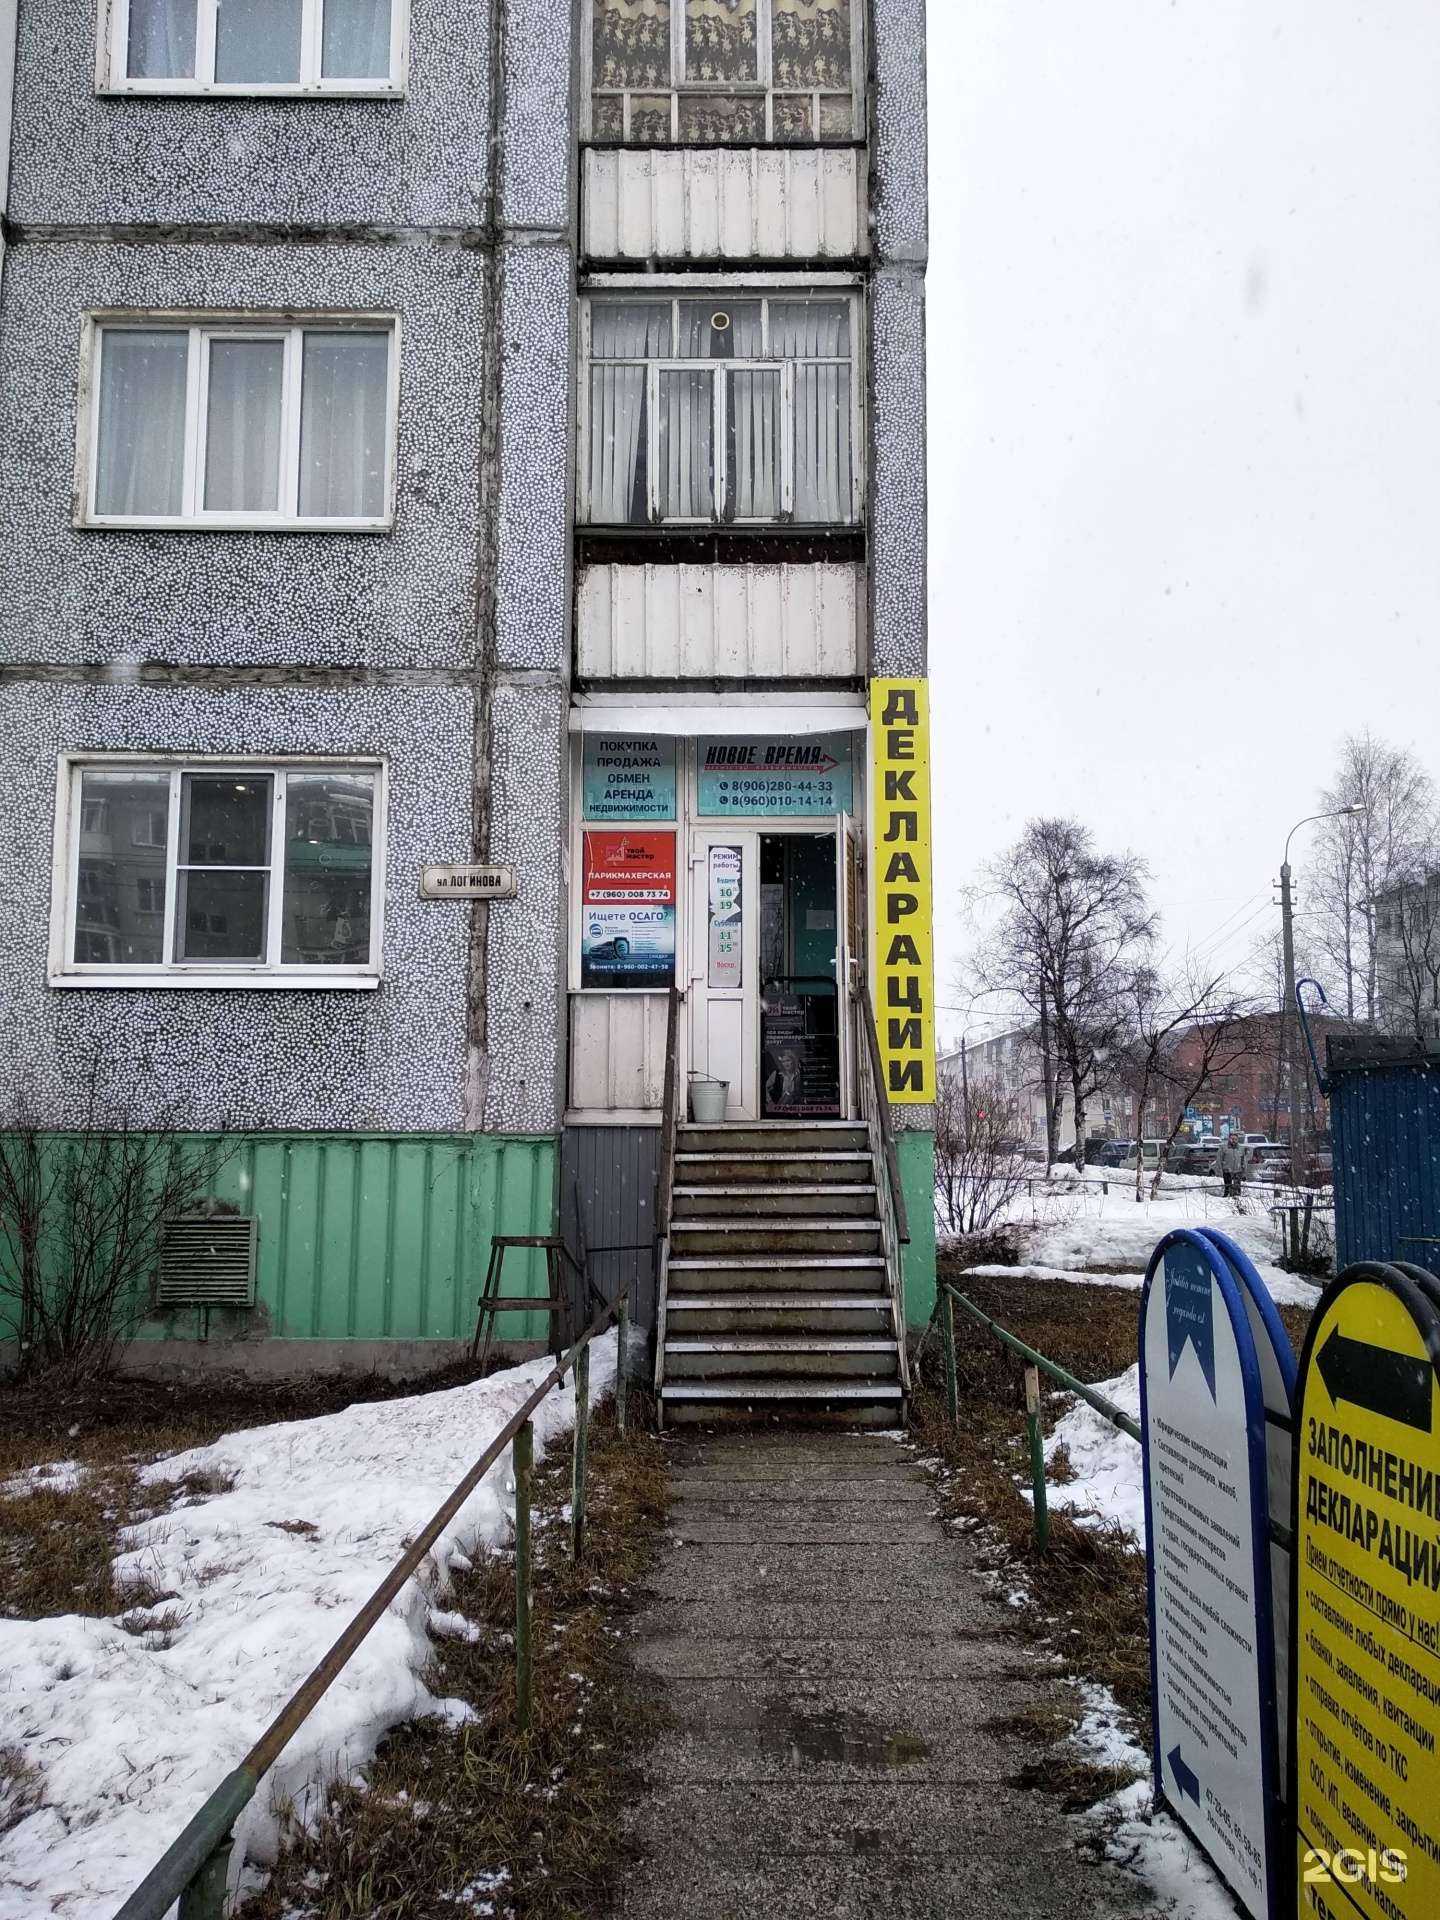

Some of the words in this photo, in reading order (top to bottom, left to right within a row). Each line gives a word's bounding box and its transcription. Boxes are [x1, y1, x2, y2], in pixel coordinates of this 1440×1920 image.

[600, 741, 658, 752] ПОКУПКА
[705, 745, 758, 764] НОВОЕ
[764, 745, 822, 764] ВРЕМЯ
[597, 757, 661, 769] ПРОДАЖА
[607, 773, 650, 783] ОБМЕН
[731, 780, 833, 793] 8(906)280-44-33
[604, 789, 654, 801] АРЕНДА
[731, 795, 833, 808] 8(960)010-14-14
[589, 804, 669, 813] НЕДВИЖИМОСТИ
[450, 875, 501, 887] ЛОГИНОВА
[881, 689, 924, 1093] ДЕКЛАРАЦИИ
[589, 912, 626, 921] Ищете
[629, 912, 669, 921] ОСАГО?
[719, 931, 731, 939] 11
[719, 944, 732, 952] 15
[1157, 1417, 1191, 1446] Юридические
[1191, 1440, 1228, 1470] консультации
[1158, 1439, 1188, 1466] Составление
[1306, 1534, 1328, 1573] Прием
[1328, 1558, 1374, 1609] отчетности
[1376, 1590, 1407, 1630] прямо
[1408, 1611, 1416, 1642] у
[1310, 1590, 1353, 1640] составление
[1356, 1627, 1386, 1666] любых
[1310, 1676, 1340, 1721] отправка
[1341, 1708, 1374, 1752] отчётов
[1375, 1738, 1387, 1763] по
[1389, 1743, 1408, 1781] ТКС
[1382, 1696, 1435, 1753] квитанции
[1342, 1801, 1377, 1851] ведение
